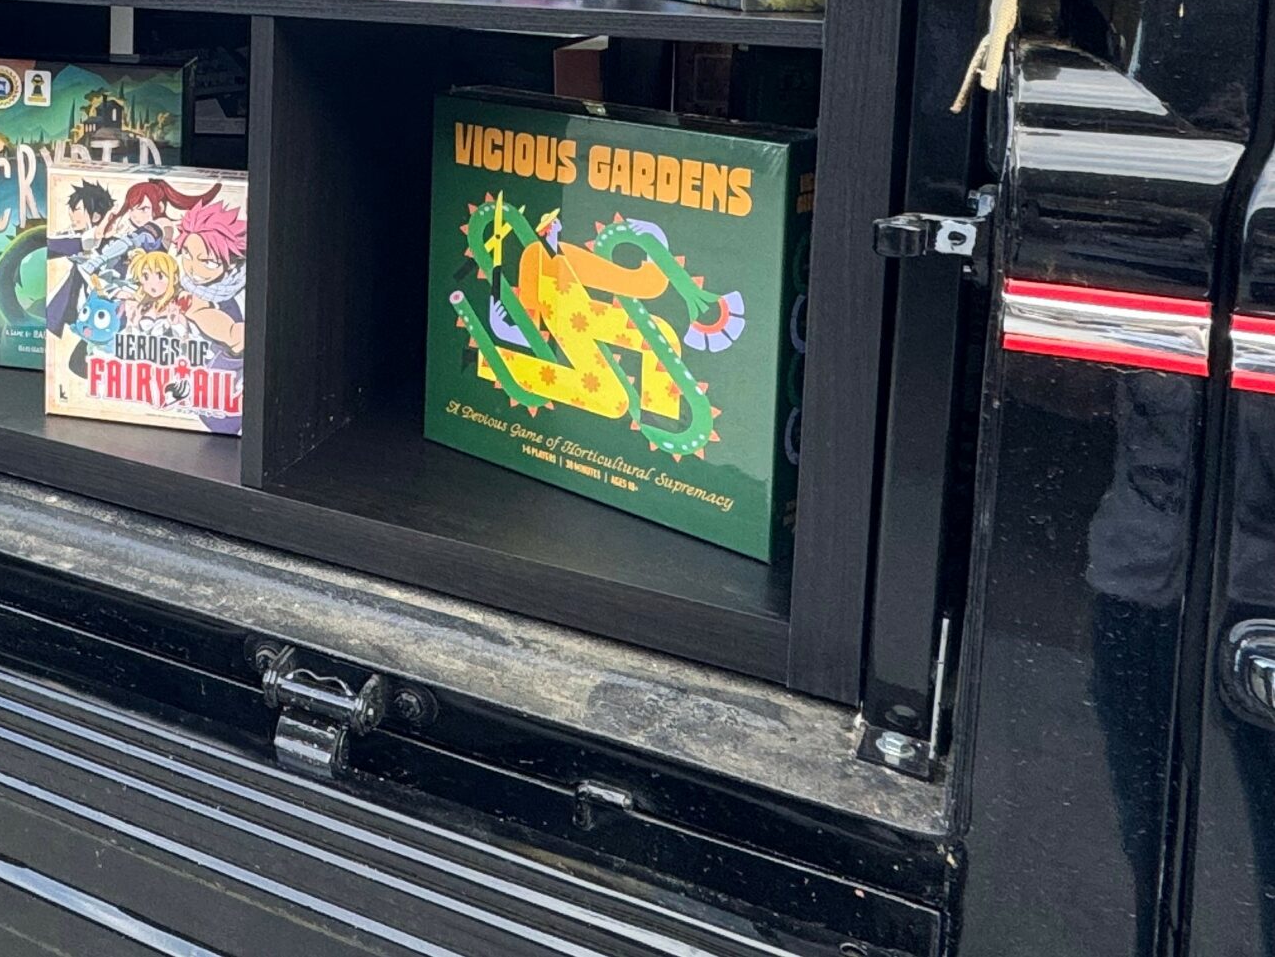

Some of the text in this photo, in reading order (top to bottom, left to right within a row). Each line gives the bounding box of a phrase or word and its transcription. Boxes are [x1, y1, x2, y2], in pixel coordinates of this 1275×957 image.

[454, 122, 578, 185] VICIOUS
[587, 144, 753, 217] GARDENS
[87, 358, 169, 407] FAIRY
[115, 333, 211, 367] HEROES OF
[462, 405, 507, 432] Devious
[510, 423, 543, 444] Game
[546, 434, 561, 451] of
[561, 440, 656, 482] Horticultural
[655, 473, 735, 512] Supremacy
